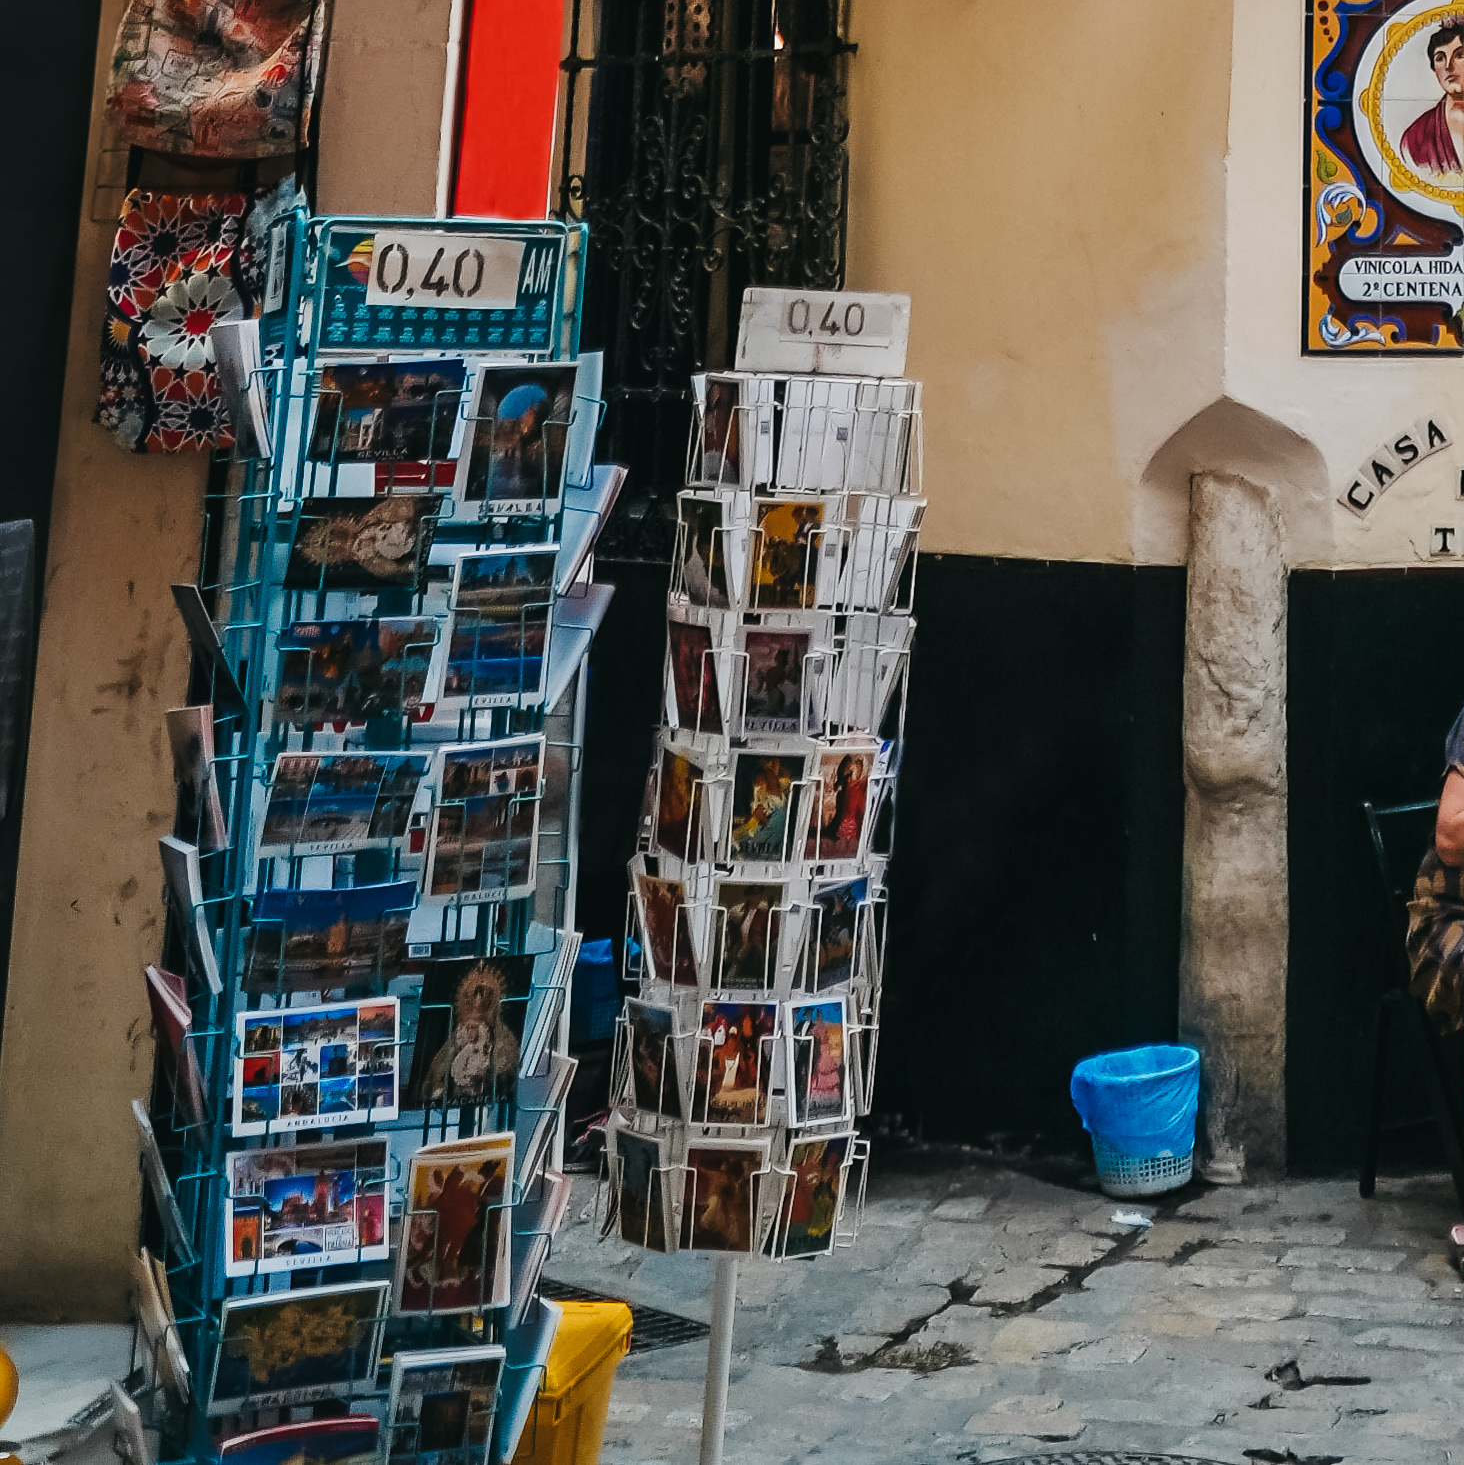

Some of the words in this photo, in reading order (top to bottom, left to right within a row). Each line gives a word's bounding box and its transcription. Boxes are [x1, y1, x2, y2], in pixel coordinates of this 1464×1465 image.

[376, 243, 484, 300] 0,40
[1354, 260, 1424, 275] VINICOLA
[1347, 420, 1447, 511] CASA
